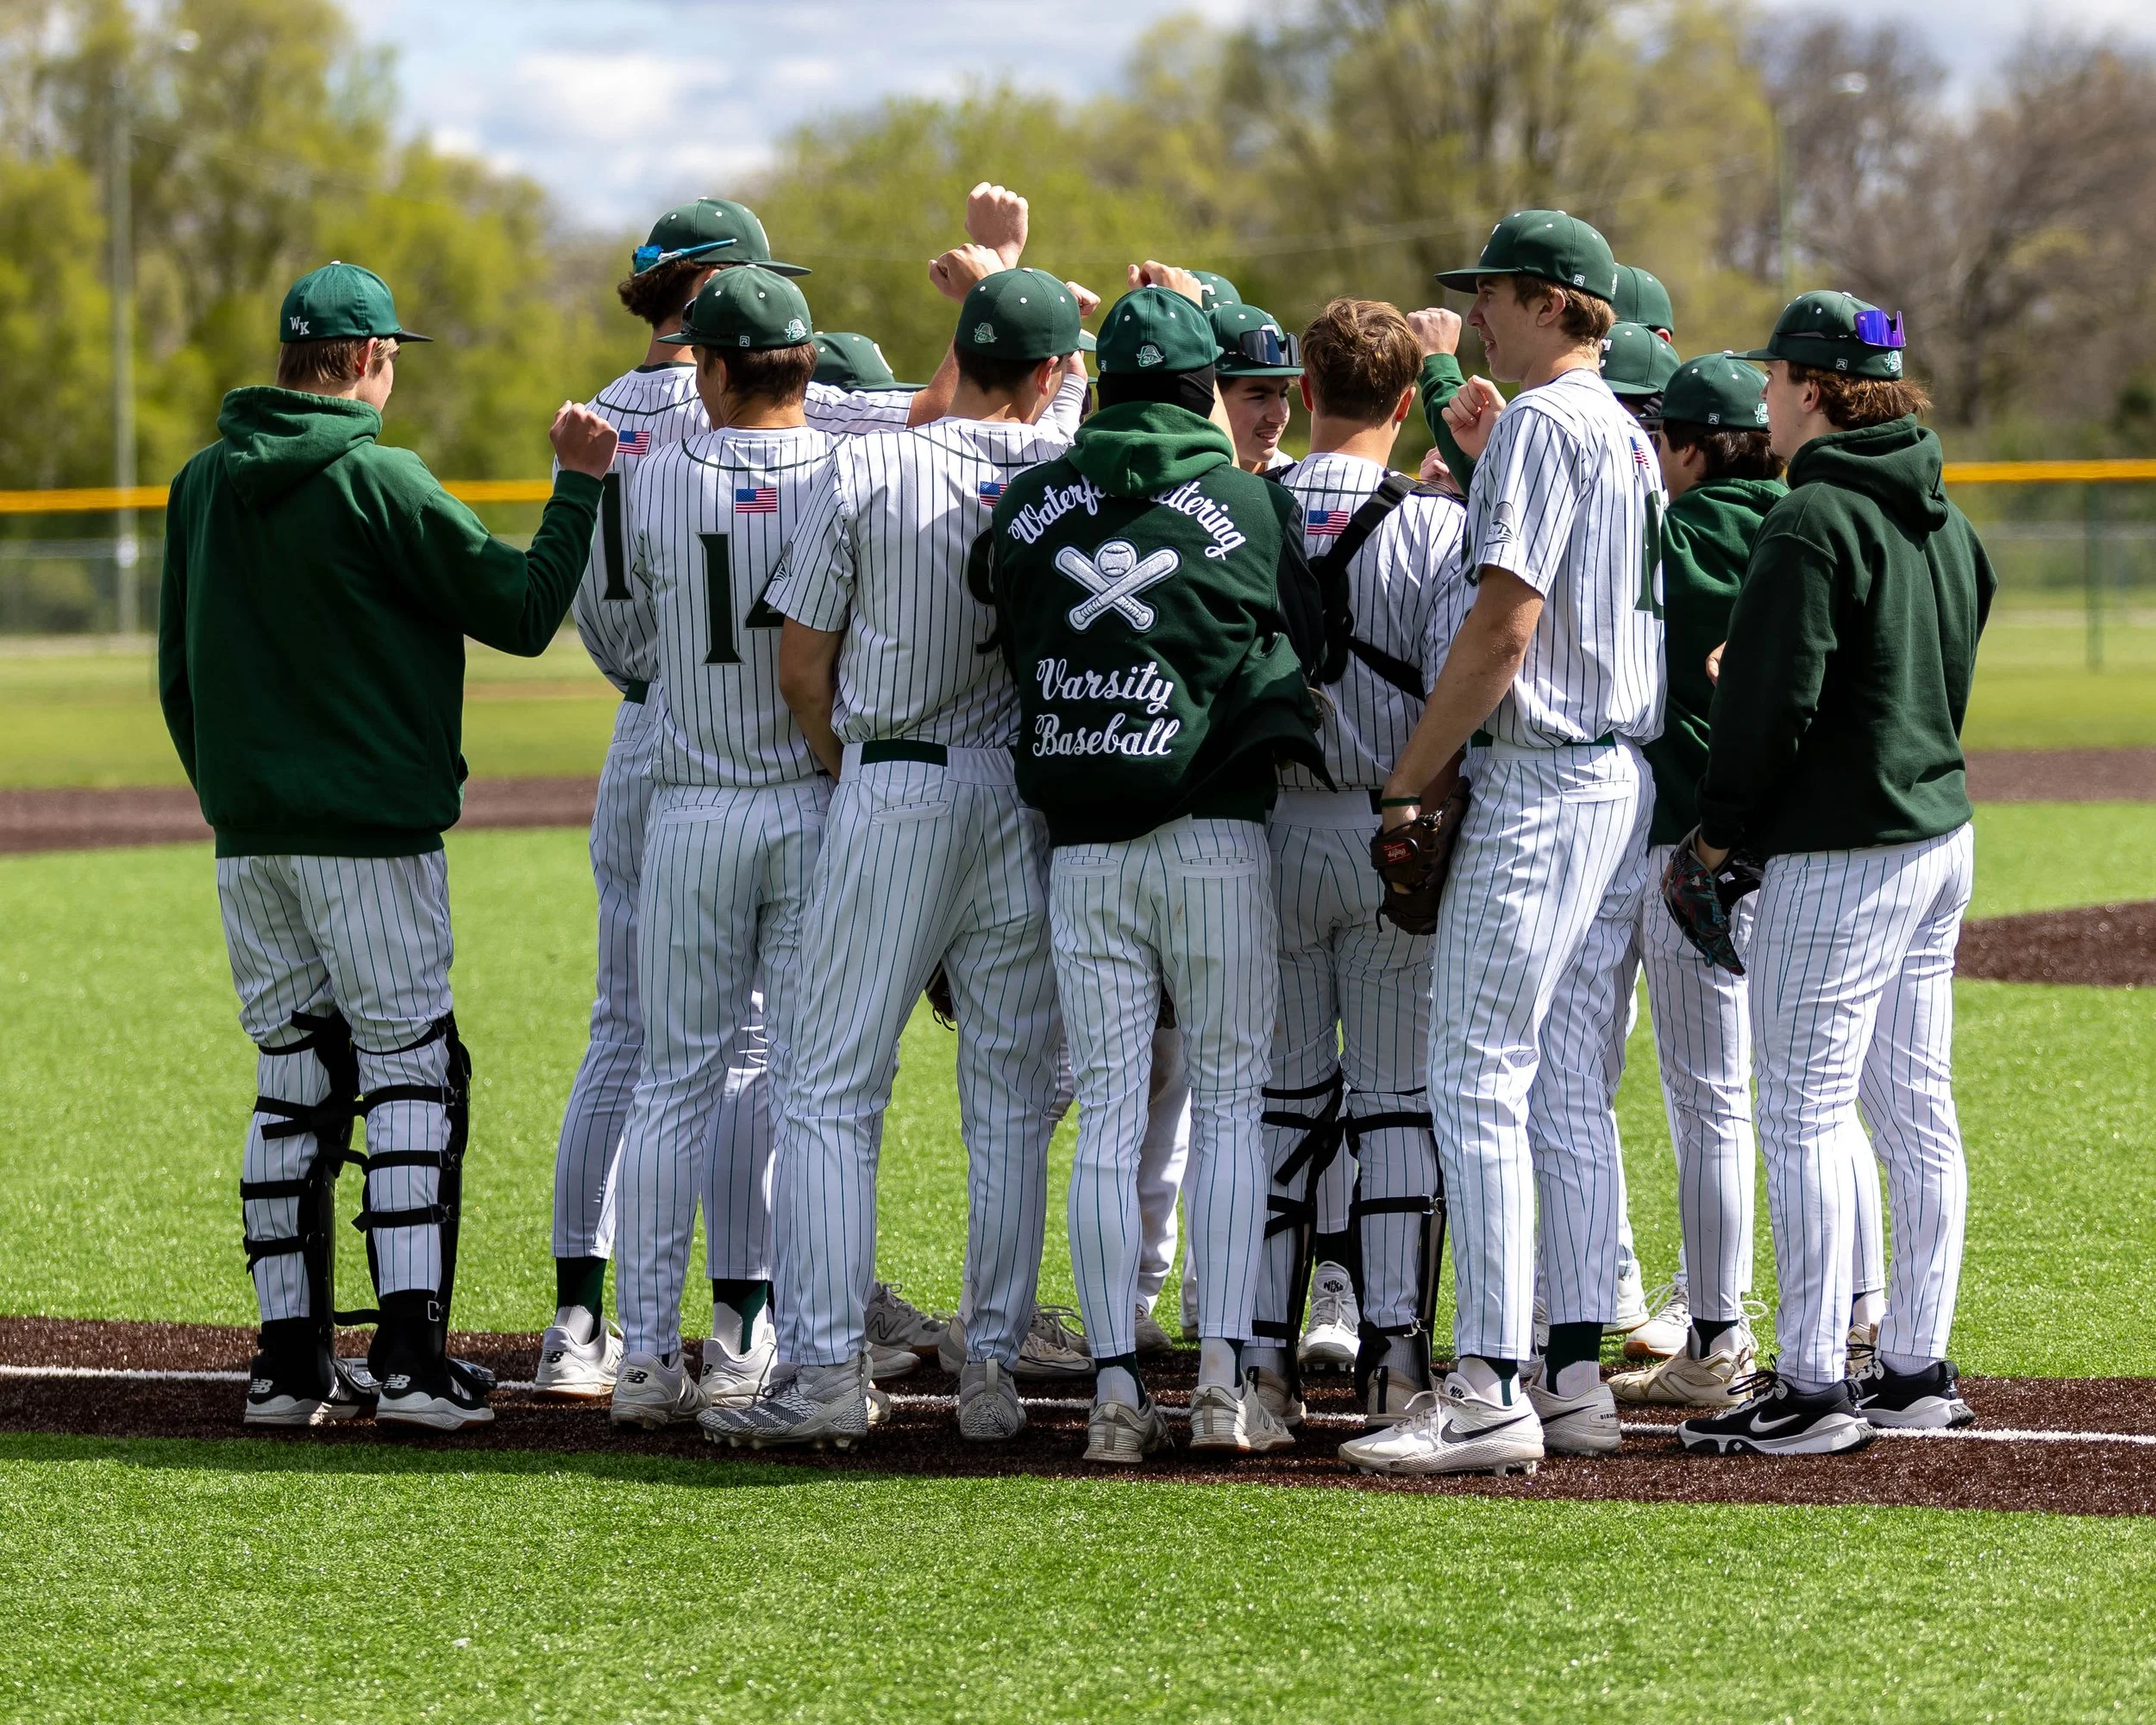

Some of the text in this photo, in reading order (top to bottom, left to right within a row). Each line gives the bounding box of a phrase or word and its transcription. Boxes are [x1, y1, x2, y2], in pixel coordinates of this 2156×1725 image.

[1149, 480, 1246, 561] ettering
[1037, 658, 1174, 714] Varsity
[1032, 712, 1180, 756] Baseball
